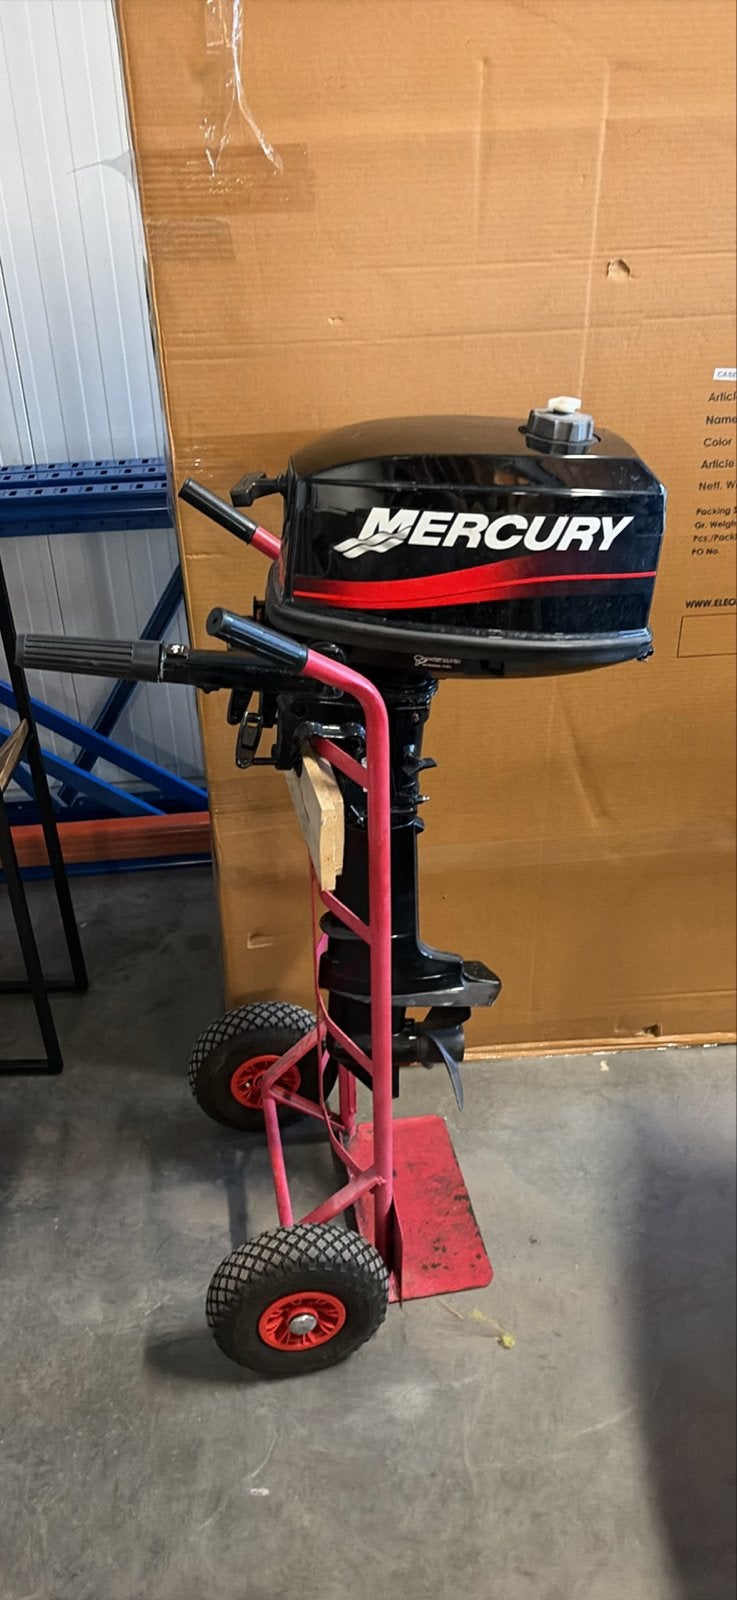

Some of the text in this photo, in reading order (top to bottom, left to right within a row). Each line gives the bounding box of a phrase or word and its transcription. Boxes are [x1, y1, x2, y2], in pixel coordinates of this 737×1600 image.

[708, 391, 736, 402] Articl
[703, 437, 732, 447] Color
[701, 459, 734, 469] Article
[696, 507, 731, 516] Packing
[335, 506, 635, 558] MERCURY
[691, 548, 704, 556] PO
